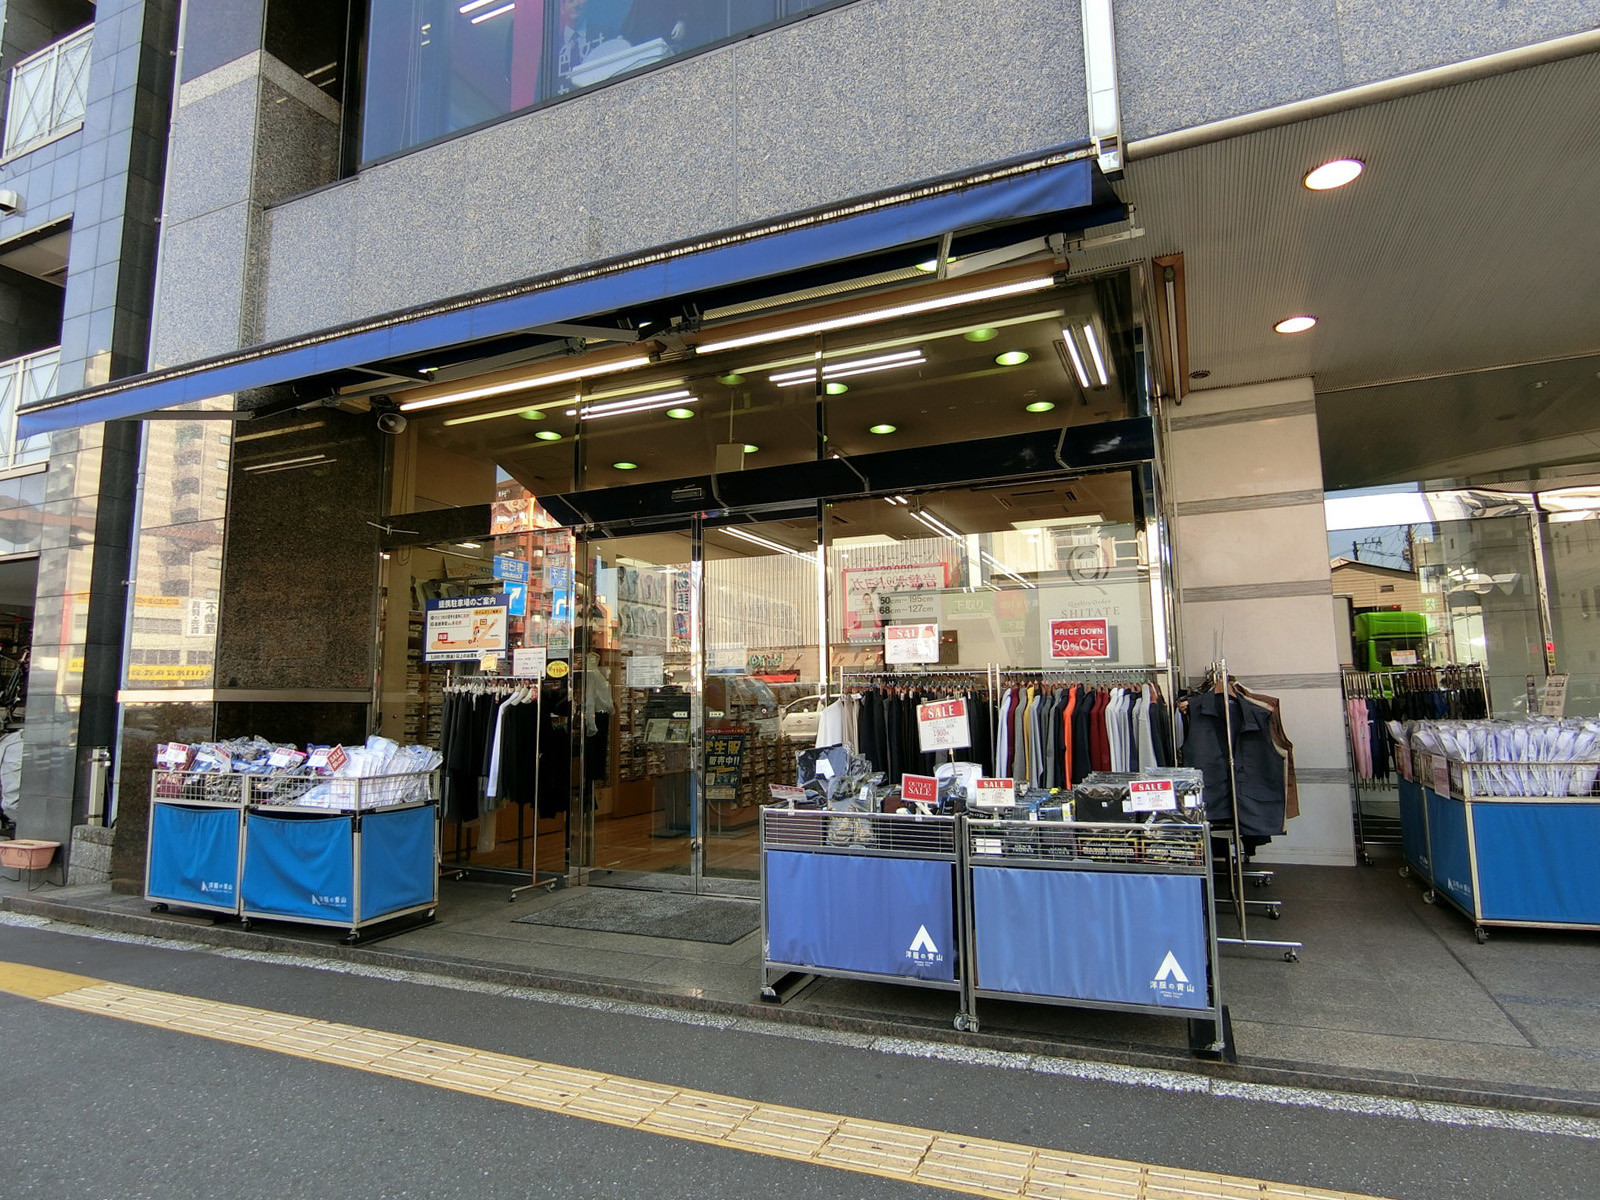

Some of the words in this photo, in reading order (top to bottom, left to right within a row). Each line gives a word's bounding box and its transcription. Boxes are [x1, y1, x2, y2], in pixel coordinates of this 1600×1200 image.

[438, 596, 497, 609] 提携駐車場のご案内
[953, 600, 984, 611] 下取り
[1061, 606, 1120, 618] SHITATE
[896, 629, 919, 639] SAL
[1054, 628, 1078, 636] PRICE
[1080, 627, 1103, 635] DOWN
[1053, 638, 1105, 651] 50%OFF
[928, 704, 955, 719] SALE
[908, 781, 932, 789] OUTLET
[1138, 783, 1163, 791] SALE
[908, 787, 932, 796] SALE
[905, 950, 943, 962] 洋服の青山
[1149, 980, 1195, 993] 洋服の青山
